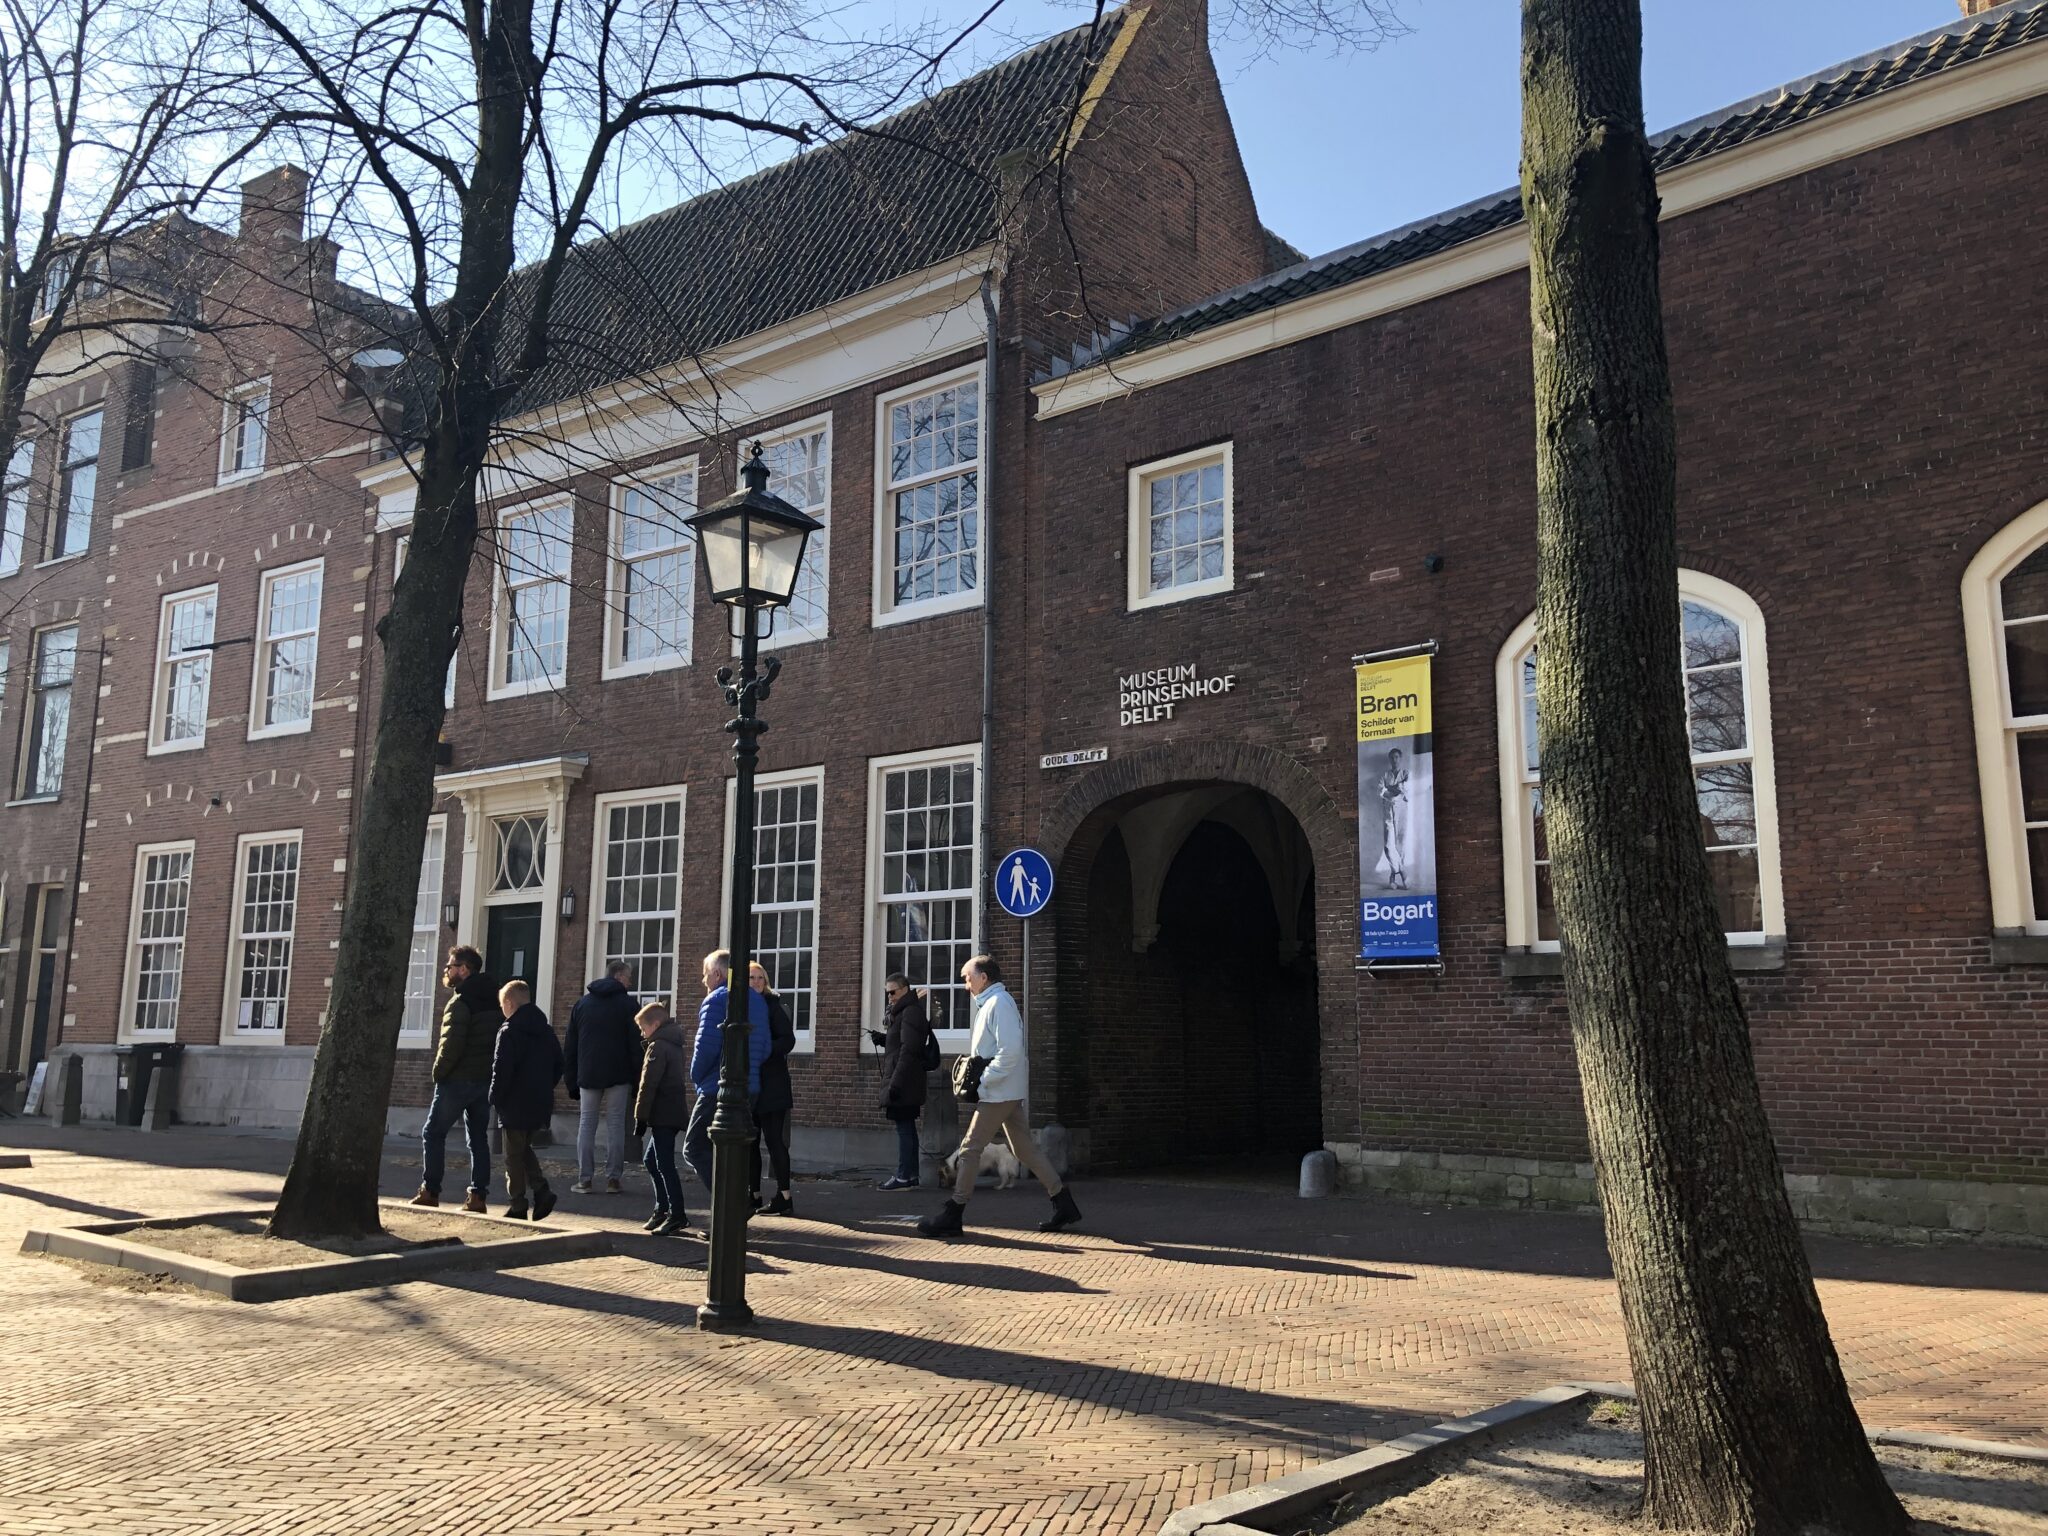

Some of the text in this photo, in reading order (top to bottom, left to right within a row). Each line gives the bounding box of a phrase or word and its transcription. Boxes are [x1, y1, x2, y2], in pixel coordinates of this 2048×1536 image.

[1120, 663, 1196, 692] MUSEUM
[1120, 674, 1236, 709] PRINSENHOF
[1120, 702, 1175, 727] DELFT
[1361, 693, 1418, 714] Bram
[1361, 715, 1414, 728] Schilder van
[1361, 726, 1395, 738] formaat
[1045, 749, 1104, 766] OUDE DELFT
[1364, 901, 1434, 925] Bogart
